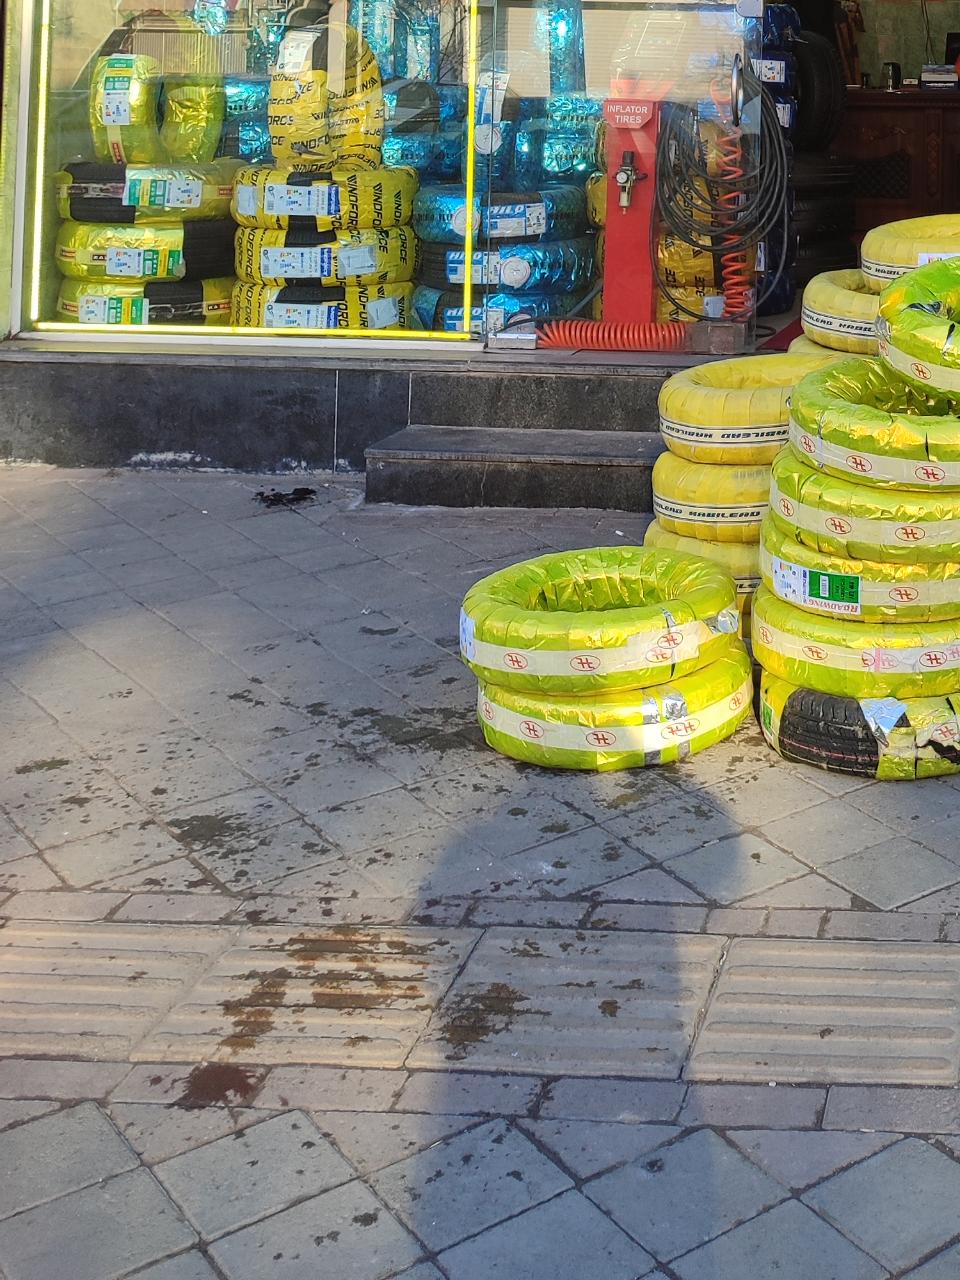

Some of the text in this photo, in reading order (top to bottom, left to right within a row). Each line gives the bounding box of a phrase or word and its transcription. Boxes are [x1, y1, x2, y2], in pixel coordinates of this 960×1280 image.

[607, 105, 648, 115] INFLATOR
[615, 115, 642, 124] TIRES
[808, 598, 859, 613] ROADWING
